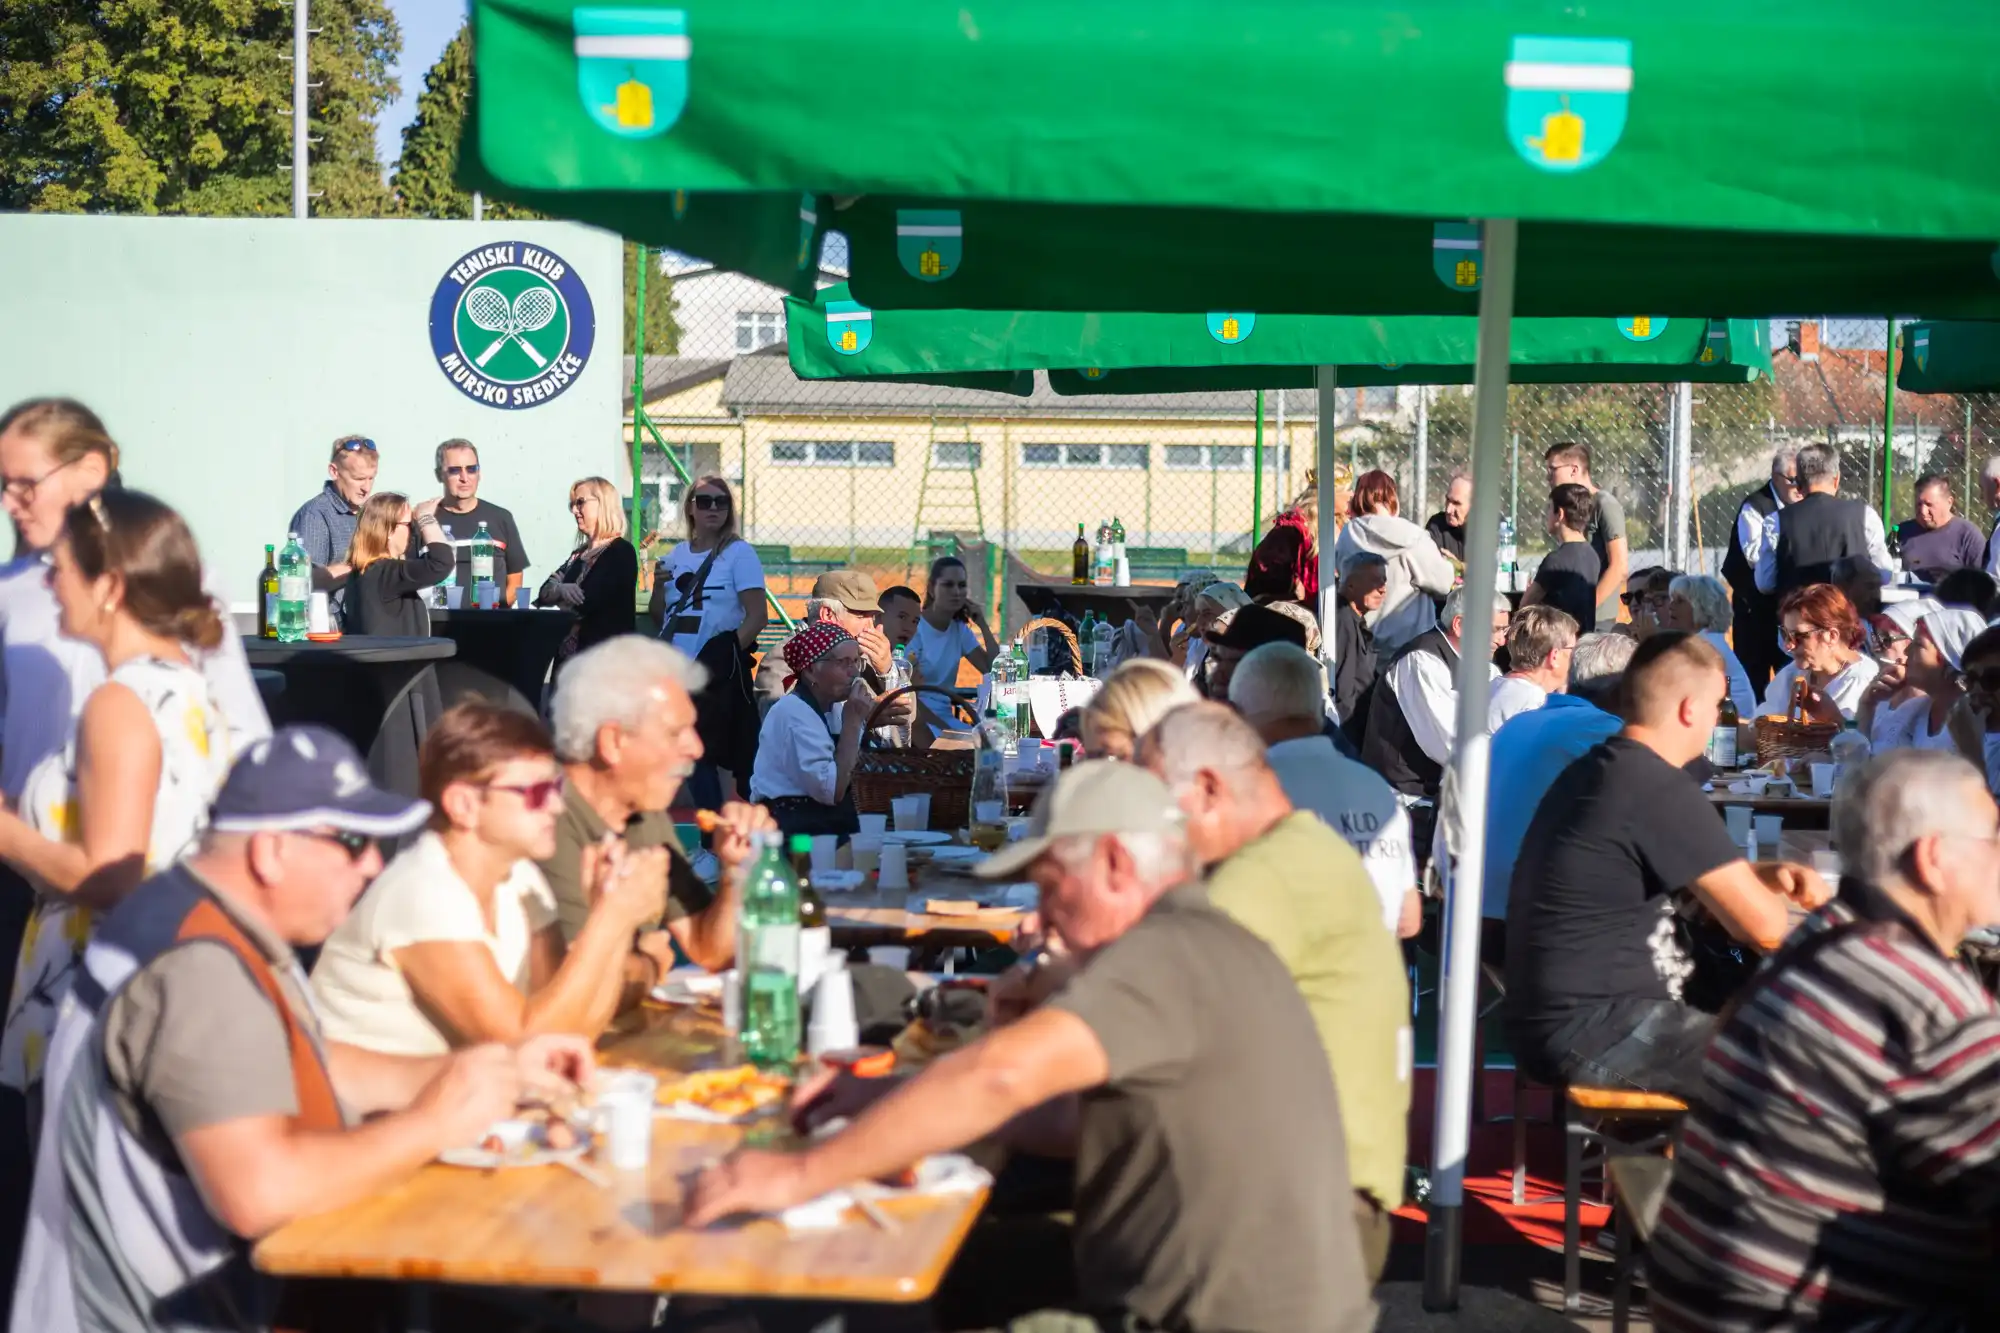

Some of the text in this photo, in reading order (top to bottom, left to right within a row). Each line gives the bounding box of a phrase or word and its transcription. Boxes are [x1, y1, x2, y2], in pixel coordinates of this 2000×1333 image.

[449, 246, 566, 286] TENISKI KLUB
[441, 352, 508, 405] MURSKO
